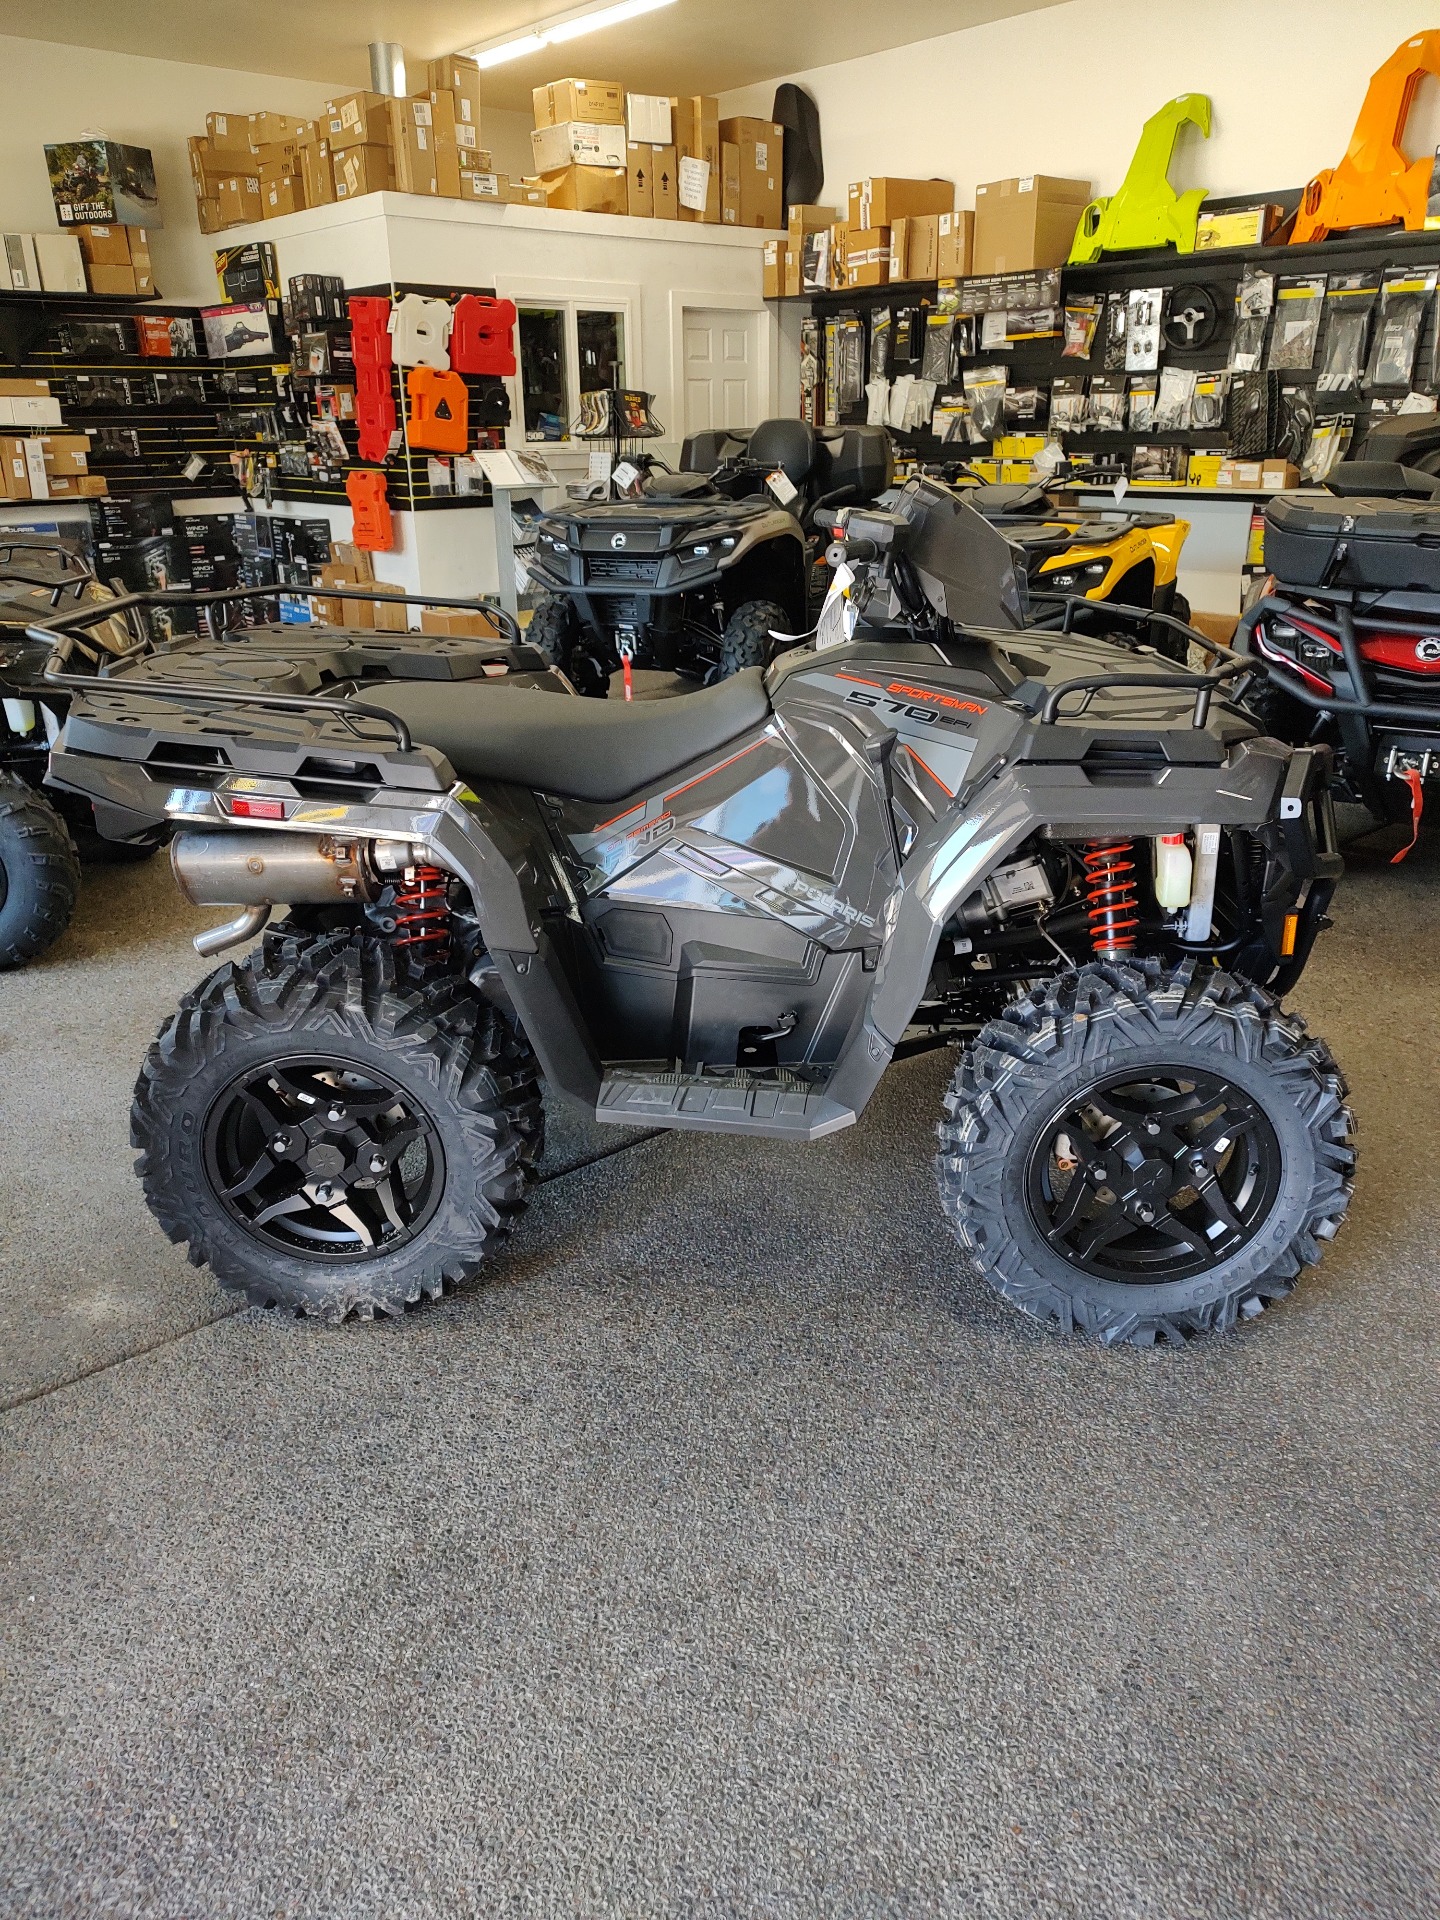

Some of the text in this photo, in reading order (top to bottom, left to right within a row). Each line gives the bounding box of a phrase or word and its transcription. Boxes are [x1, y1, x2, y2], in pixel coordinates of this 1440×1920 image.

[73, 201, 106, 211] GIFT THE
[74, 209, 113, 220] OUTDOORS
[843, 690, 973, 729] 570 EFI
[885, 682, 989, 716] SPORTSMAN
[626, 810, 671, 841] DEMAND
[793, 879, 876, 929] POLARIS
